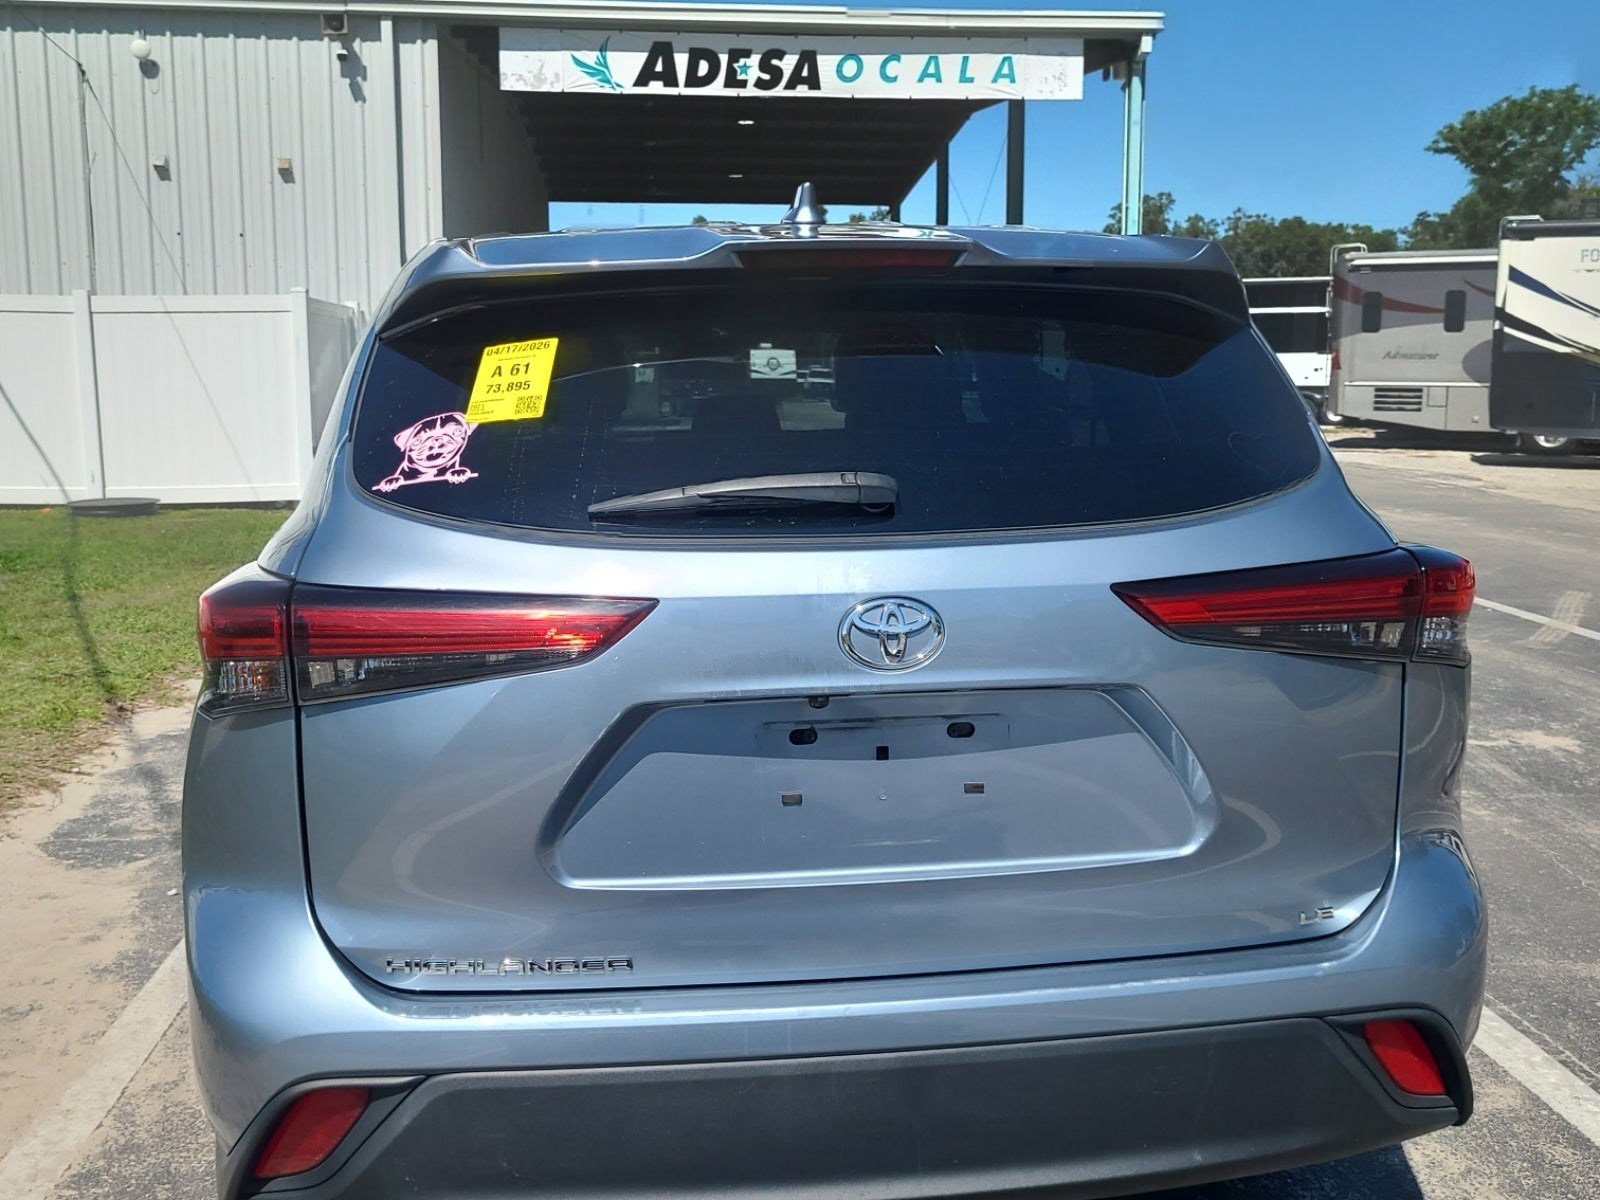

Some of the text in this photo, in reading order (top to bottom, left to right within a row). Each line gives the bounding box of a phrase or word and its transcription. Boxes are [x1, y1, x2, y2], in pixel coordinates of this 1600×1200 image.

[632, 41, 1016, 91] ADESA OCALA
[486, 341, 551, 357] 04/17/2026
[490, 362, 531, 379] A 61
[485, 381, 532, 395] 73,895
[1299, 907, 1334, 926] LE
[386, 956, 635, 976] HIGHLANDER
